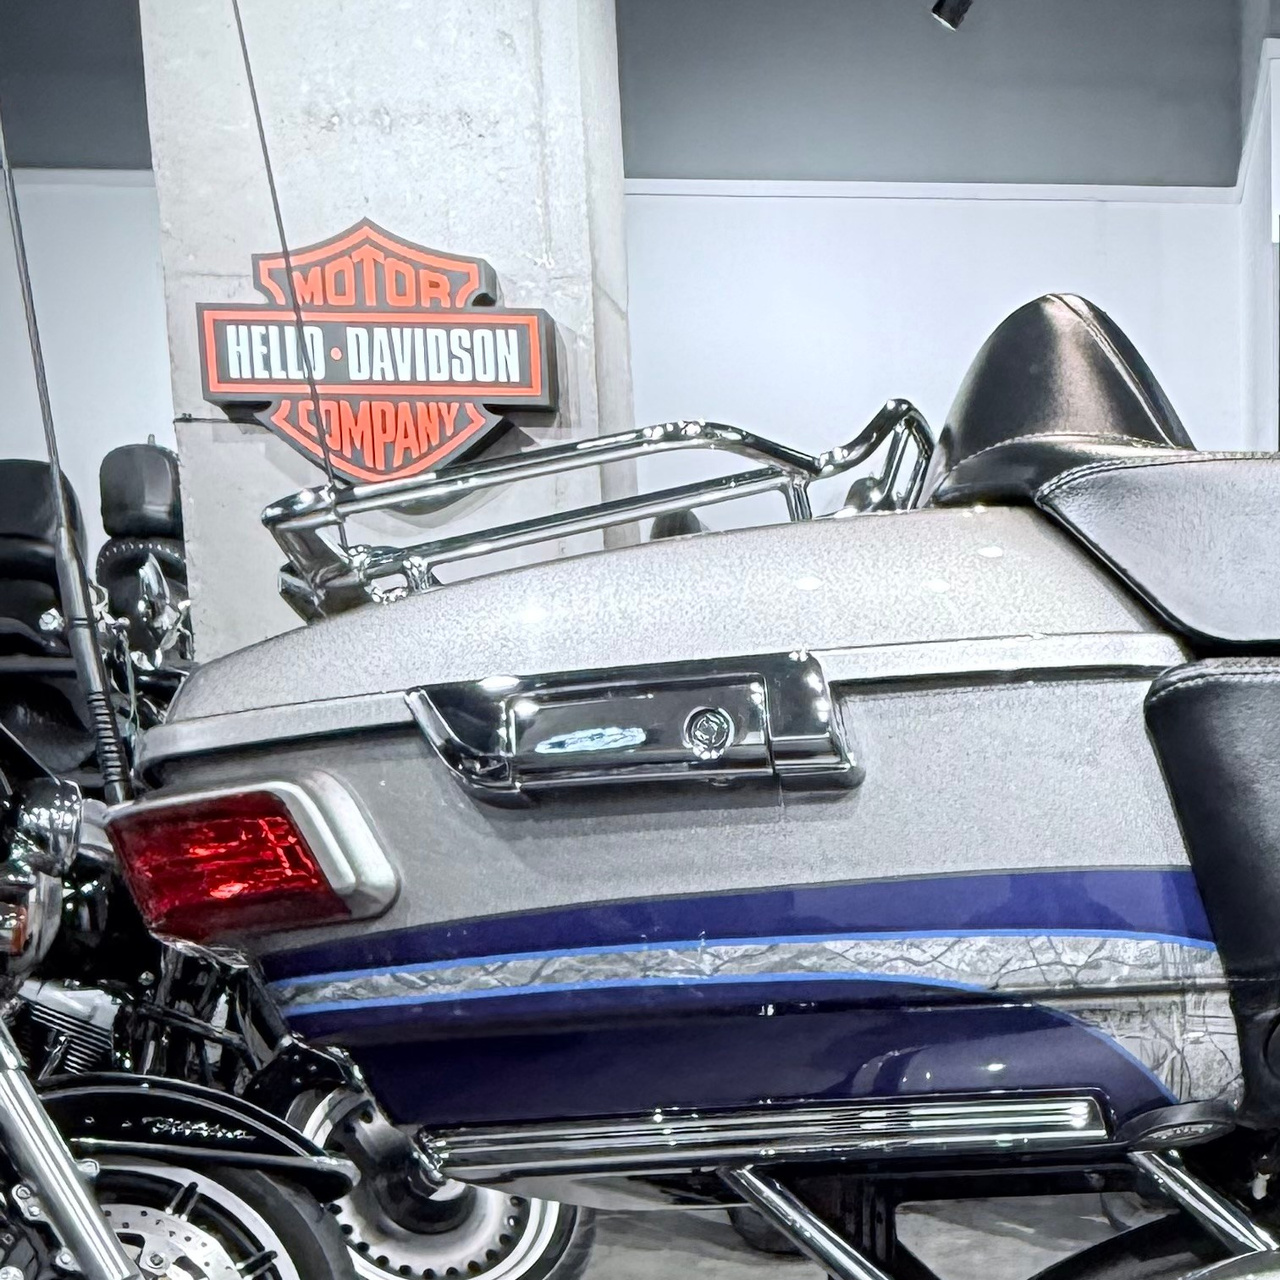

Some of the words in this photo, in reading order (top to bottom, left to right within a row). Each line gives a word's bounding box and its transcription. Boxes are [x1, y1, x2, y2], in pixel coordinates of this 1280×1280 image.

[292, 243, 451, 308] MOTOR
[226, 325, 326, 380] HELLO
[346, 325, 520, 383] DAVIDSON
[298, 399, 459, 470] COMPANY
